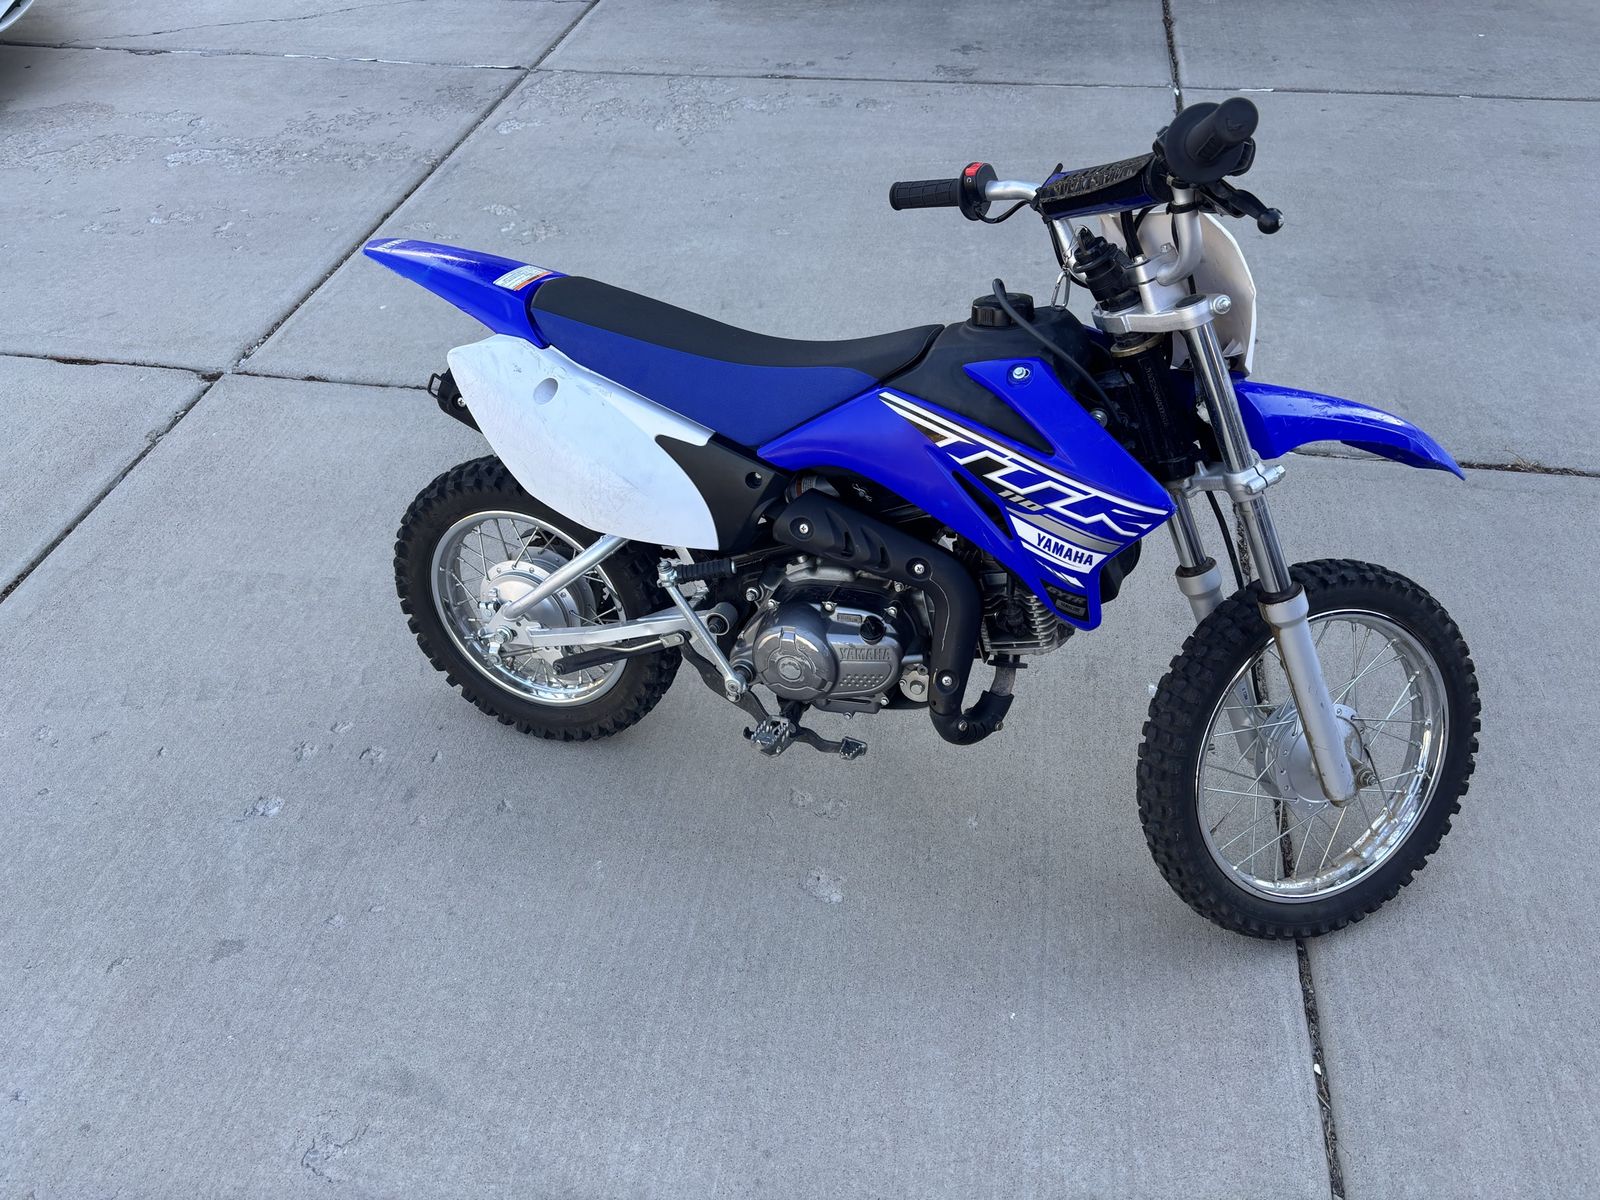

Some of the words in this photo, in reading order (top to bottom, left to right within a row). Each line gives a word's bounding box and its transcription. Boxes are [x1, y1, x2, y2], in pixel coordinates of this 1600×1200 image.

[998, 488, 1046, 512] 110
[1036, 532, 1094, 567] YAMAHA
[839, 647, 891, 661] YAMAHA
